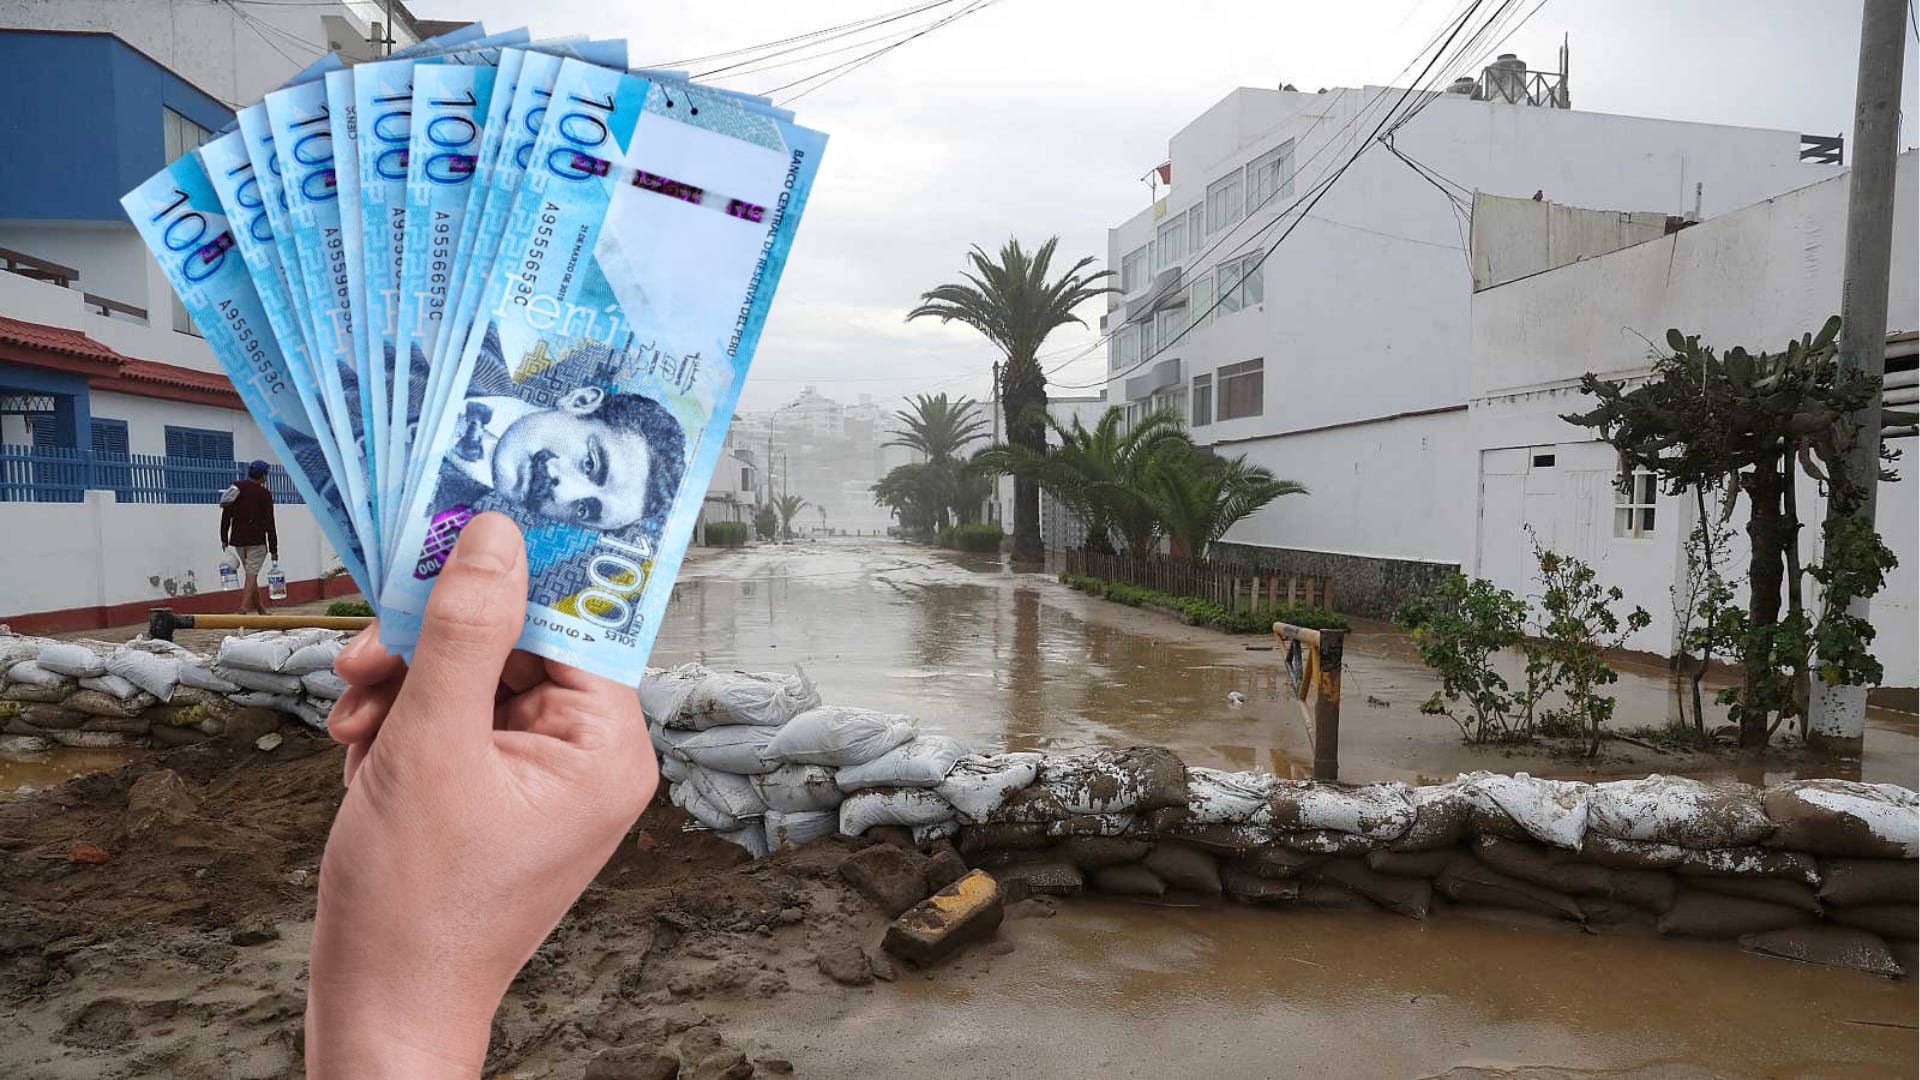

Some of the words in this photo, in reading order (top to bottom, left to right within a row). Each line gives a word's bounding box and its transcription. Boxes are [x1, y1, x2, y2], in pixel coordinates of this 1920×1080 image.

[289, 104, 339, 200] 100
[425, 90, 477, 184] 100
[547, 95, 615, 180] 100
[784, 149, 805, 190] BANCO
[151, 188, 225, 282] 100
[767, 191, 791, 238] CENTRAL
[429, 211, 450, 321] A9556653C
[513, 201, 560, 307] A9555653C
[566, 244, 582, 273] MARZO
[761, 240, 774, 256] DE
[562, 273, 573, 284] DE
[743, 257, 768, 305] RESERVA
[491, 272, 622, 347] Perú
[736, 306, 751, 327] DEL
[218, 299, 285, 395] A9559653C
[417, 558, 442, 575] 100
[576, 533, 653, 628] 100
[603, 629, 637, 648] SOLES
[629, 613, 645, 638] CIEN
